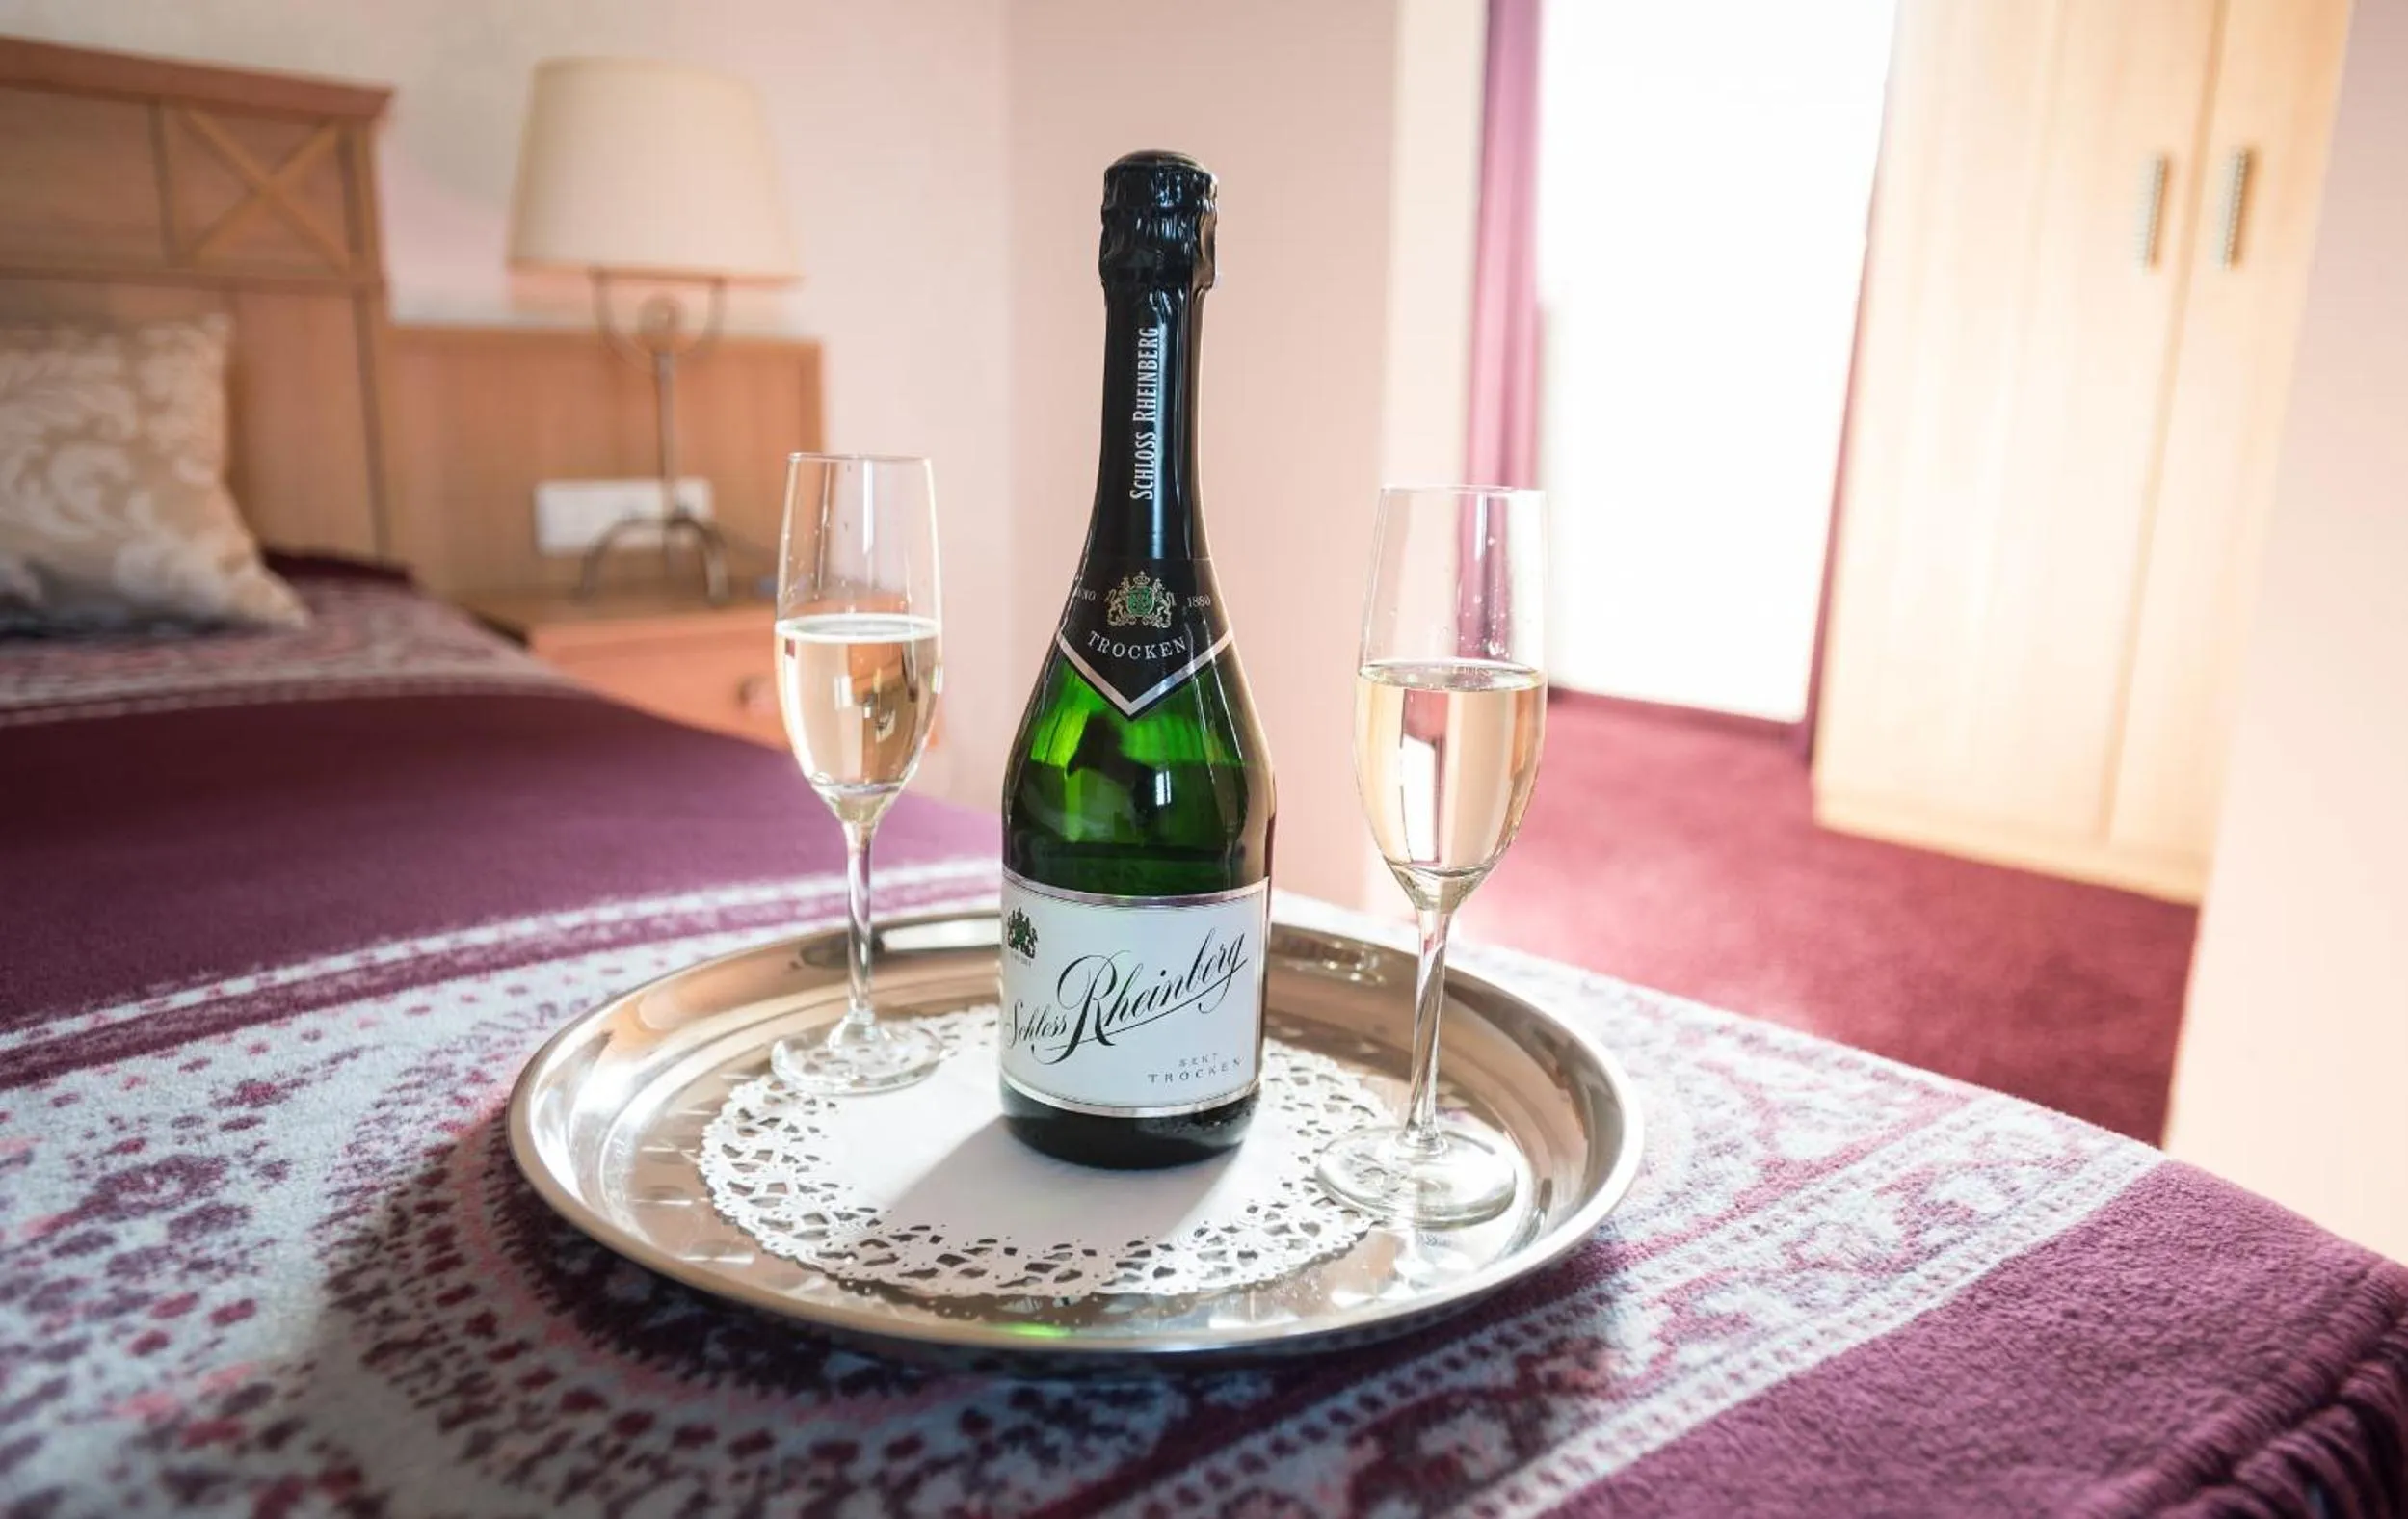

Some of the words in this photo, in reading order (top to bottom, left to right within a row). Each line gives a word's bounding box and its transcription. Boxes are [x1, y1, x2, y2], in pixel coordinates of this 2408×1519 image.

[1132, 327, 1159, 422] RHEINBERG
[1130, 432, 1156, 500] SCHLOSS
[1087, 630, 1188, 660] TROCKEN
[1004, 999, 1068, 1049] Schloss
[1031, 927, 1249, 1065] Rheinberg
[1147, 1056, 1245, 1083] TROCKEN
